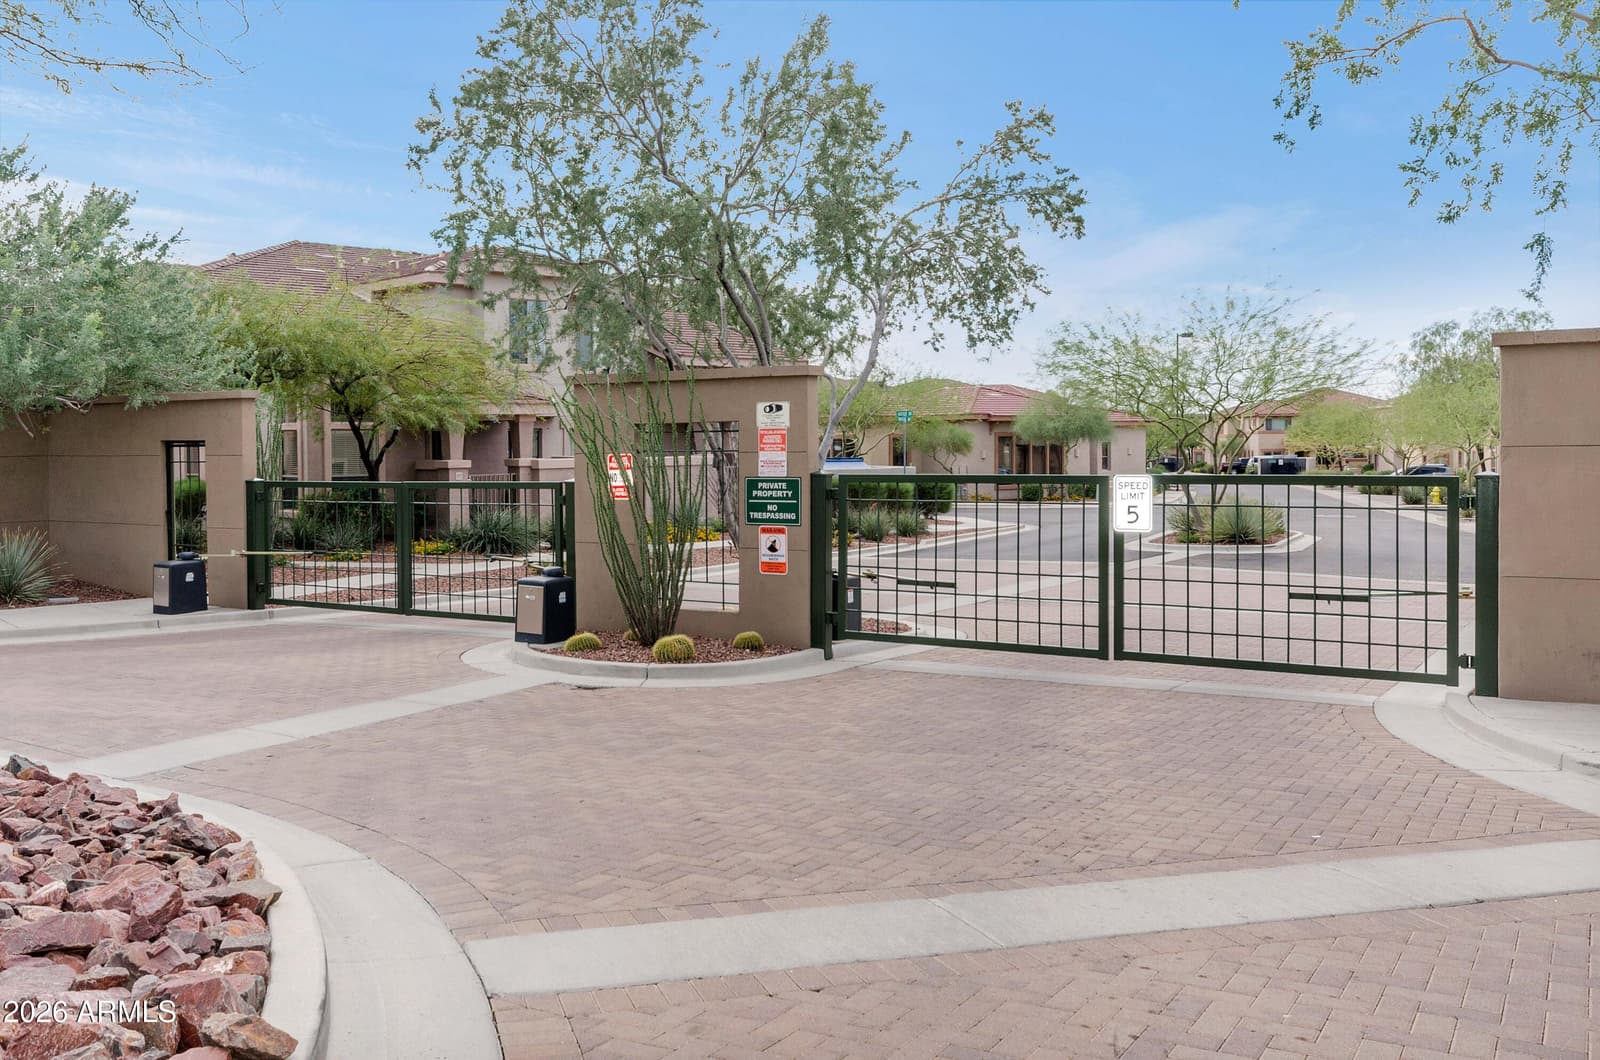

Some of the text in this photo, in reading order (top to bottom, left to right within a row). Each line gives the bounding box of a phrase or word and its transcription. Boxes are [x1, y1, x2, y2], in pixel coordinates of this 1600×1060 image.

[758, 482, 787, 490] PRIVATE
[1118, 481, 1148, 490] SPEED
[1120, 492, 1145, 500] LIMIT
[749, 511, 796, 520] TRESPASSING
[1127, 505, 1139, 524] 5
